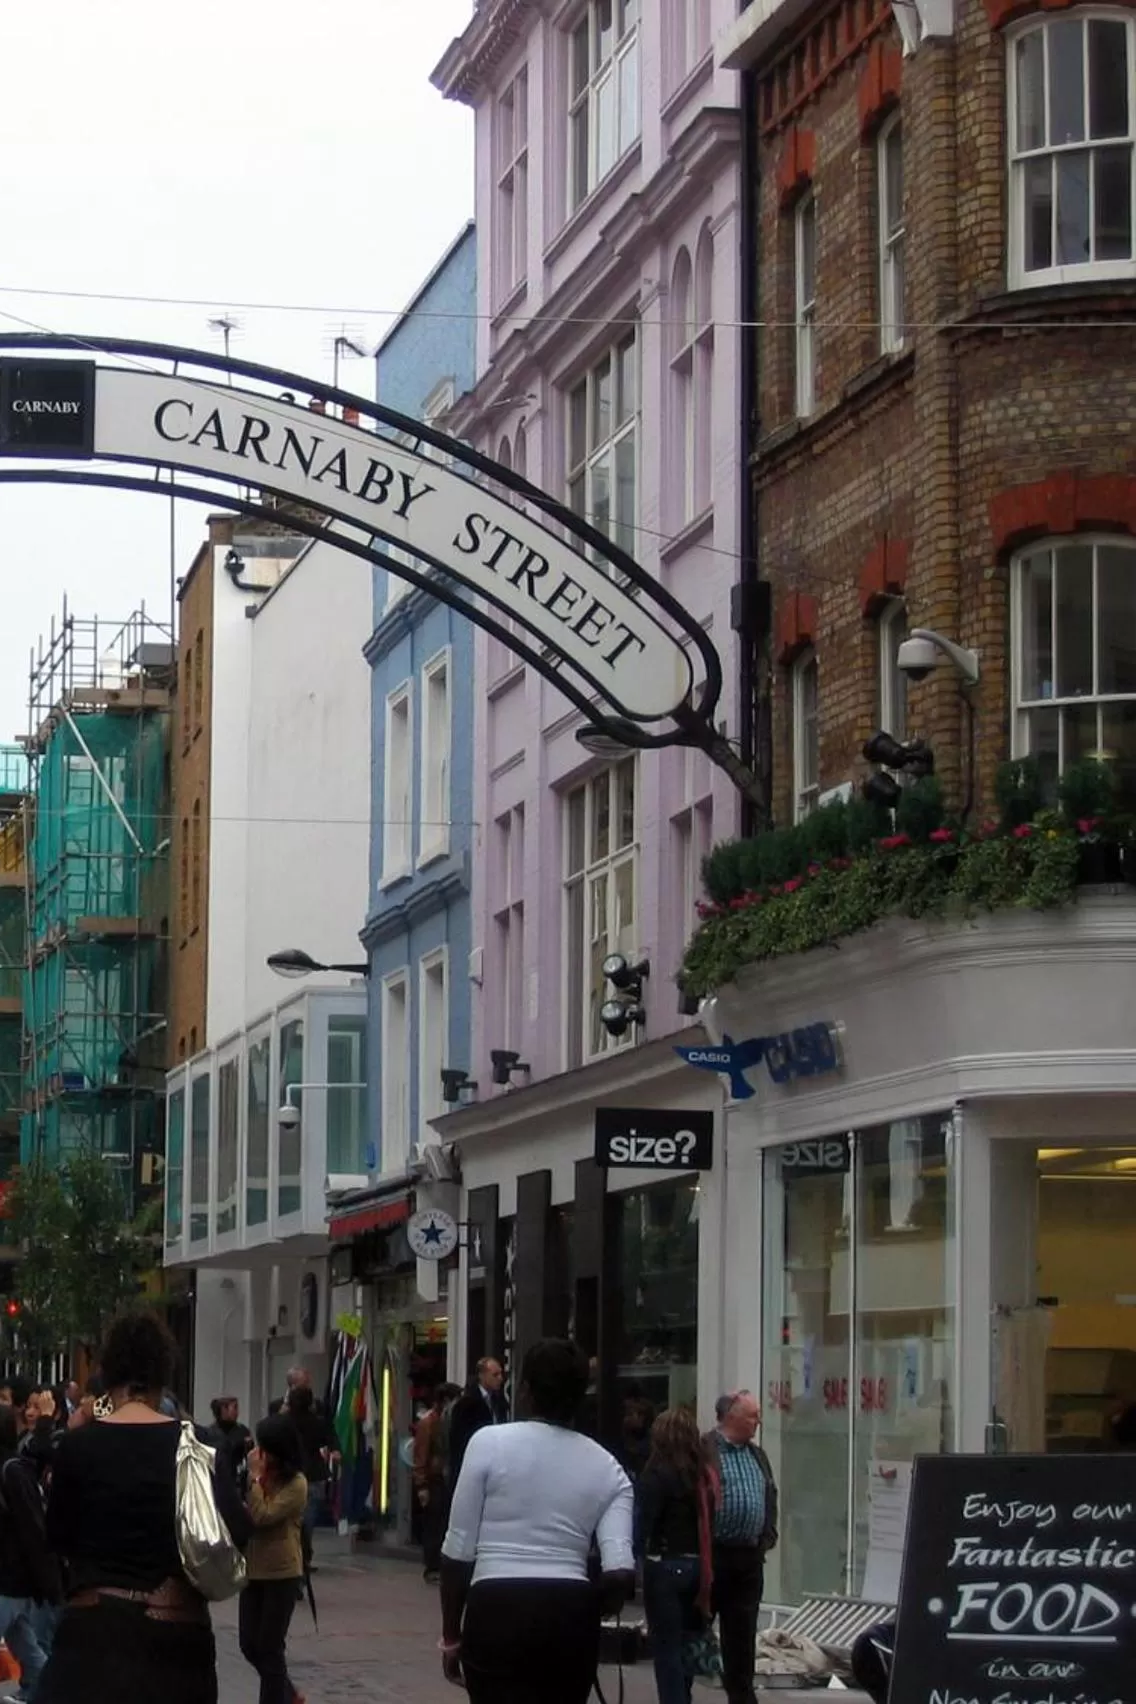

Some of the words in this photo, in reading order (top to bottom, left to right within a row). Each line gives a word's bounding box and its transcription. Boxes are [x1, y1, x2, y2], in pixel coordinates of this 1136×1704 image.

[12, 399, 81, 414] CARNABY
[154, 398, 436, 521] CARNABY
[452, 512, 646, 671] STREET
[687, 1051, 731, 1064] CASIO
[609, 1129, 697, 1164] size?
[963, 1493, 1057, 1528] Enjoy
[1072, 1503, 1133, 1520] our
[947, 1536, 1136, 1568] Fantastic
[949, 1582, 1121, 1633] FOOD
[987, 1656, 1020, 1678] in
